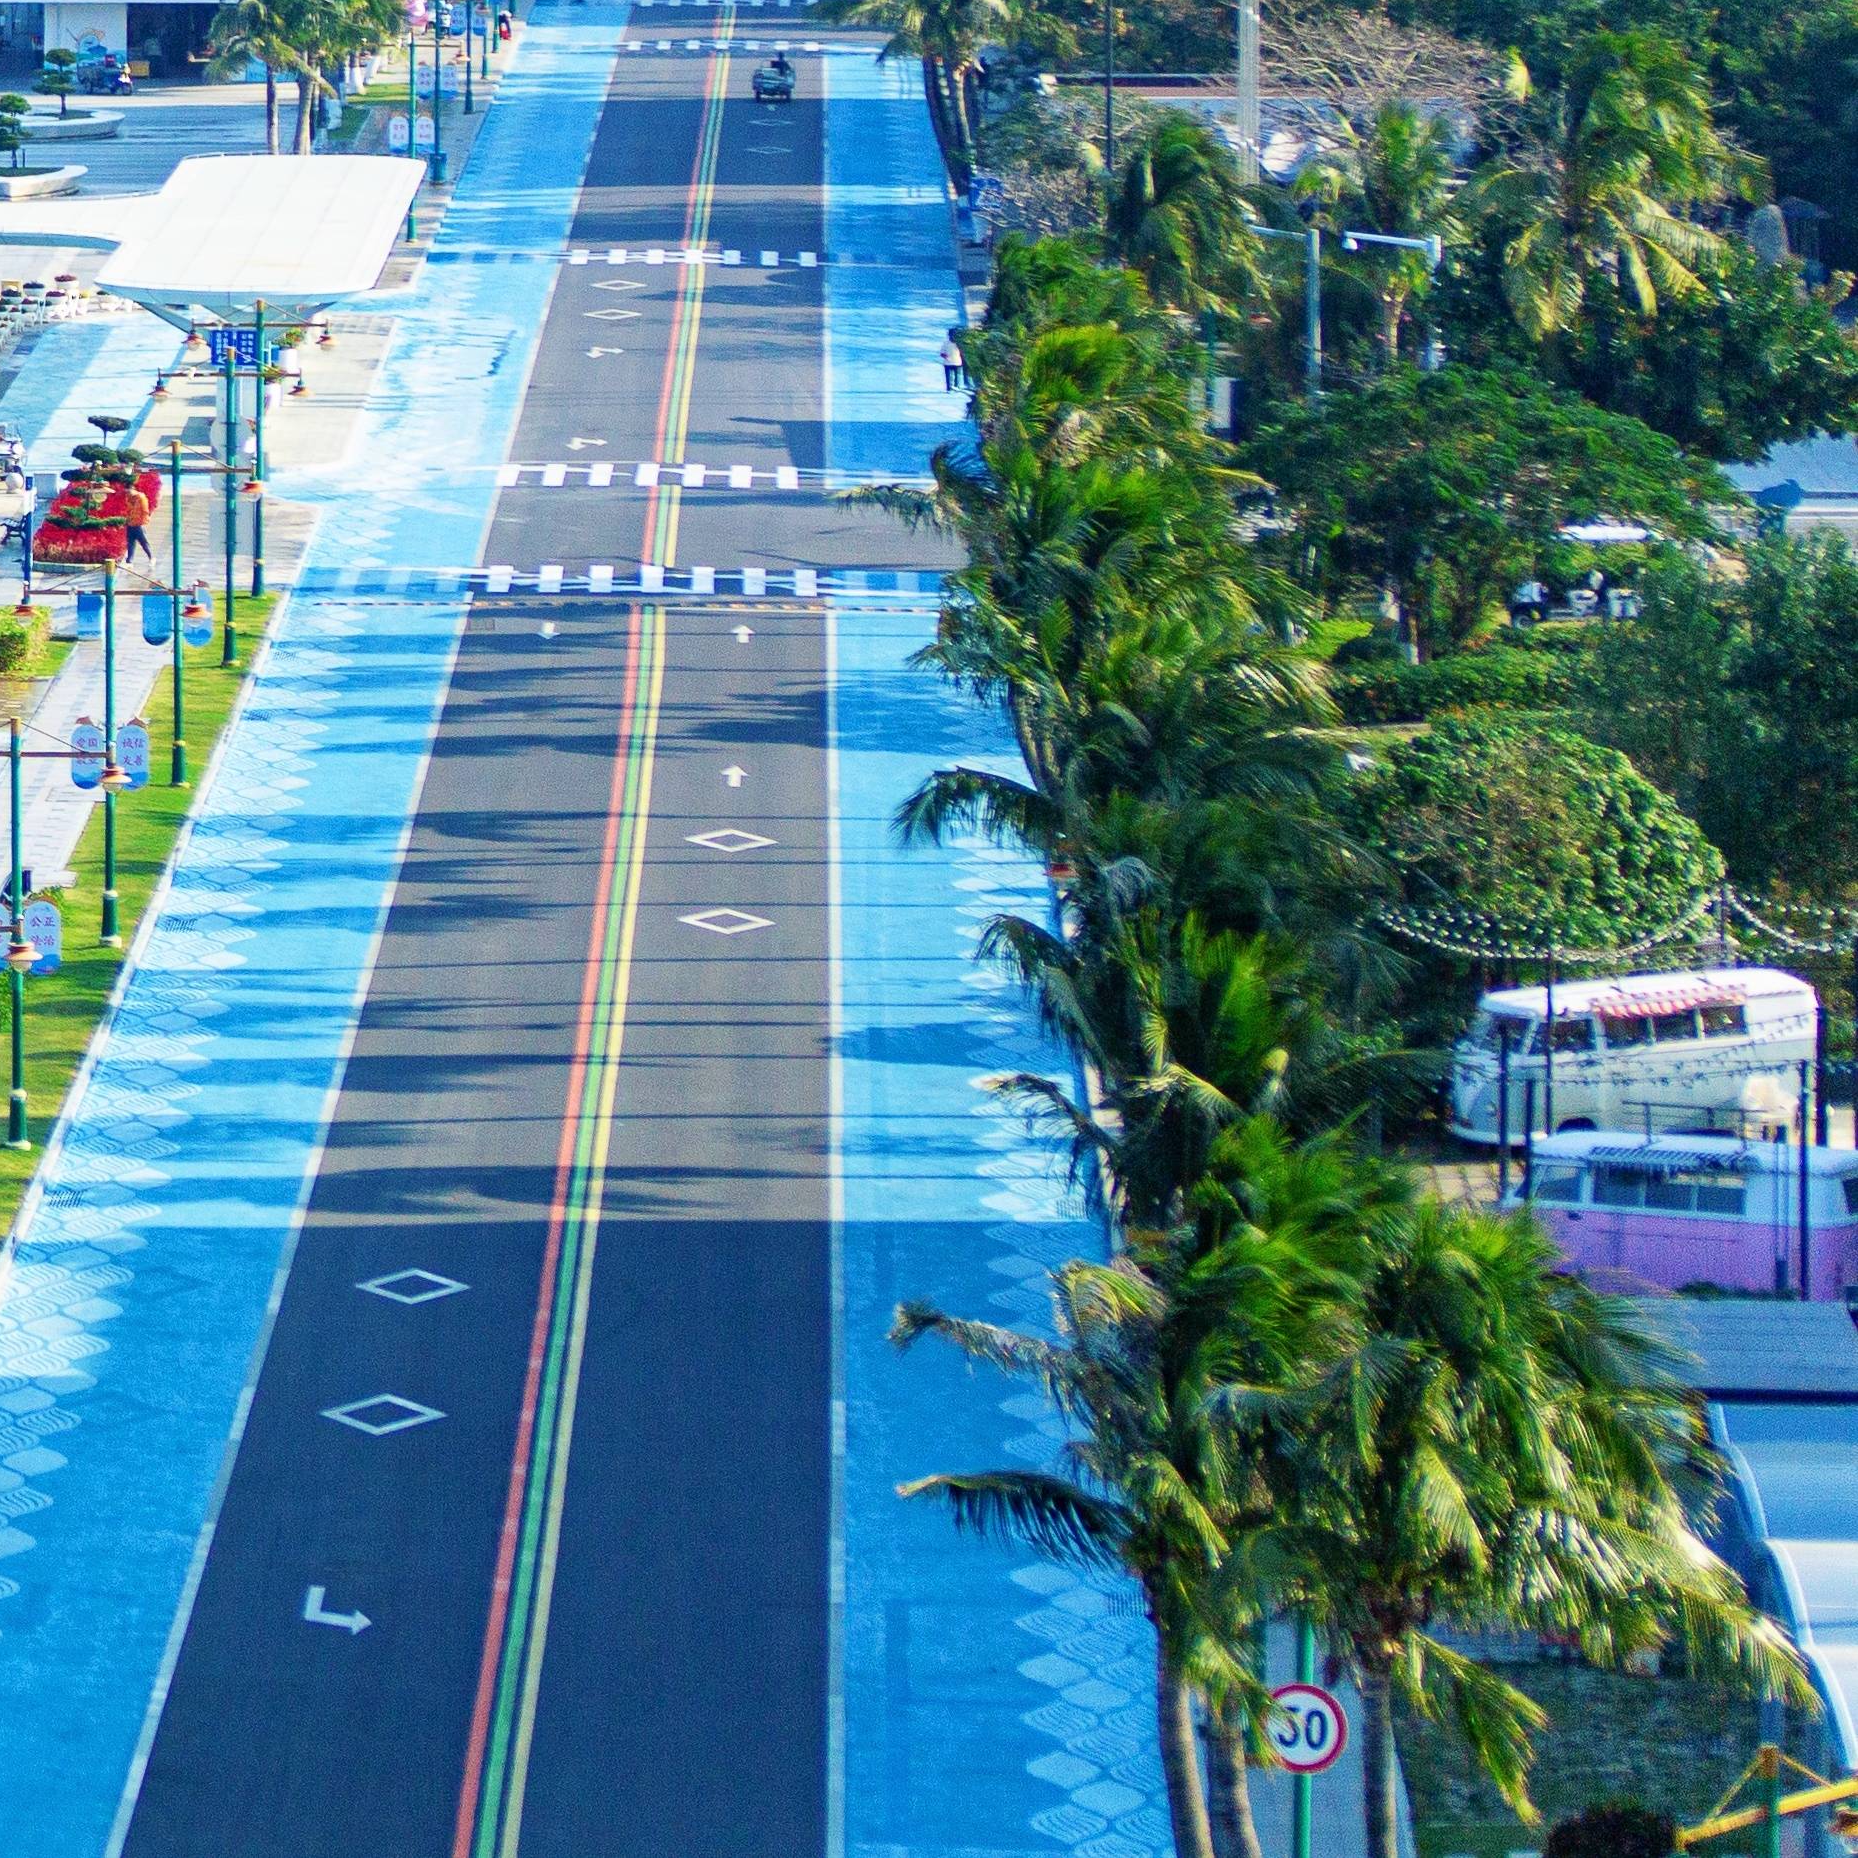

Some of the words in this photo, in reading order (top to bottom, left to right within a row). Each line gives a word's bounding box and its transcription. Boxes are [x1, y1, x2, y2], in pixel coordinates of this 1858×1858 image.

[123, 737, 143, 749] 诚信
[30, 916, 55, 927] 公正
[30, 934, 55, 946] 法治
